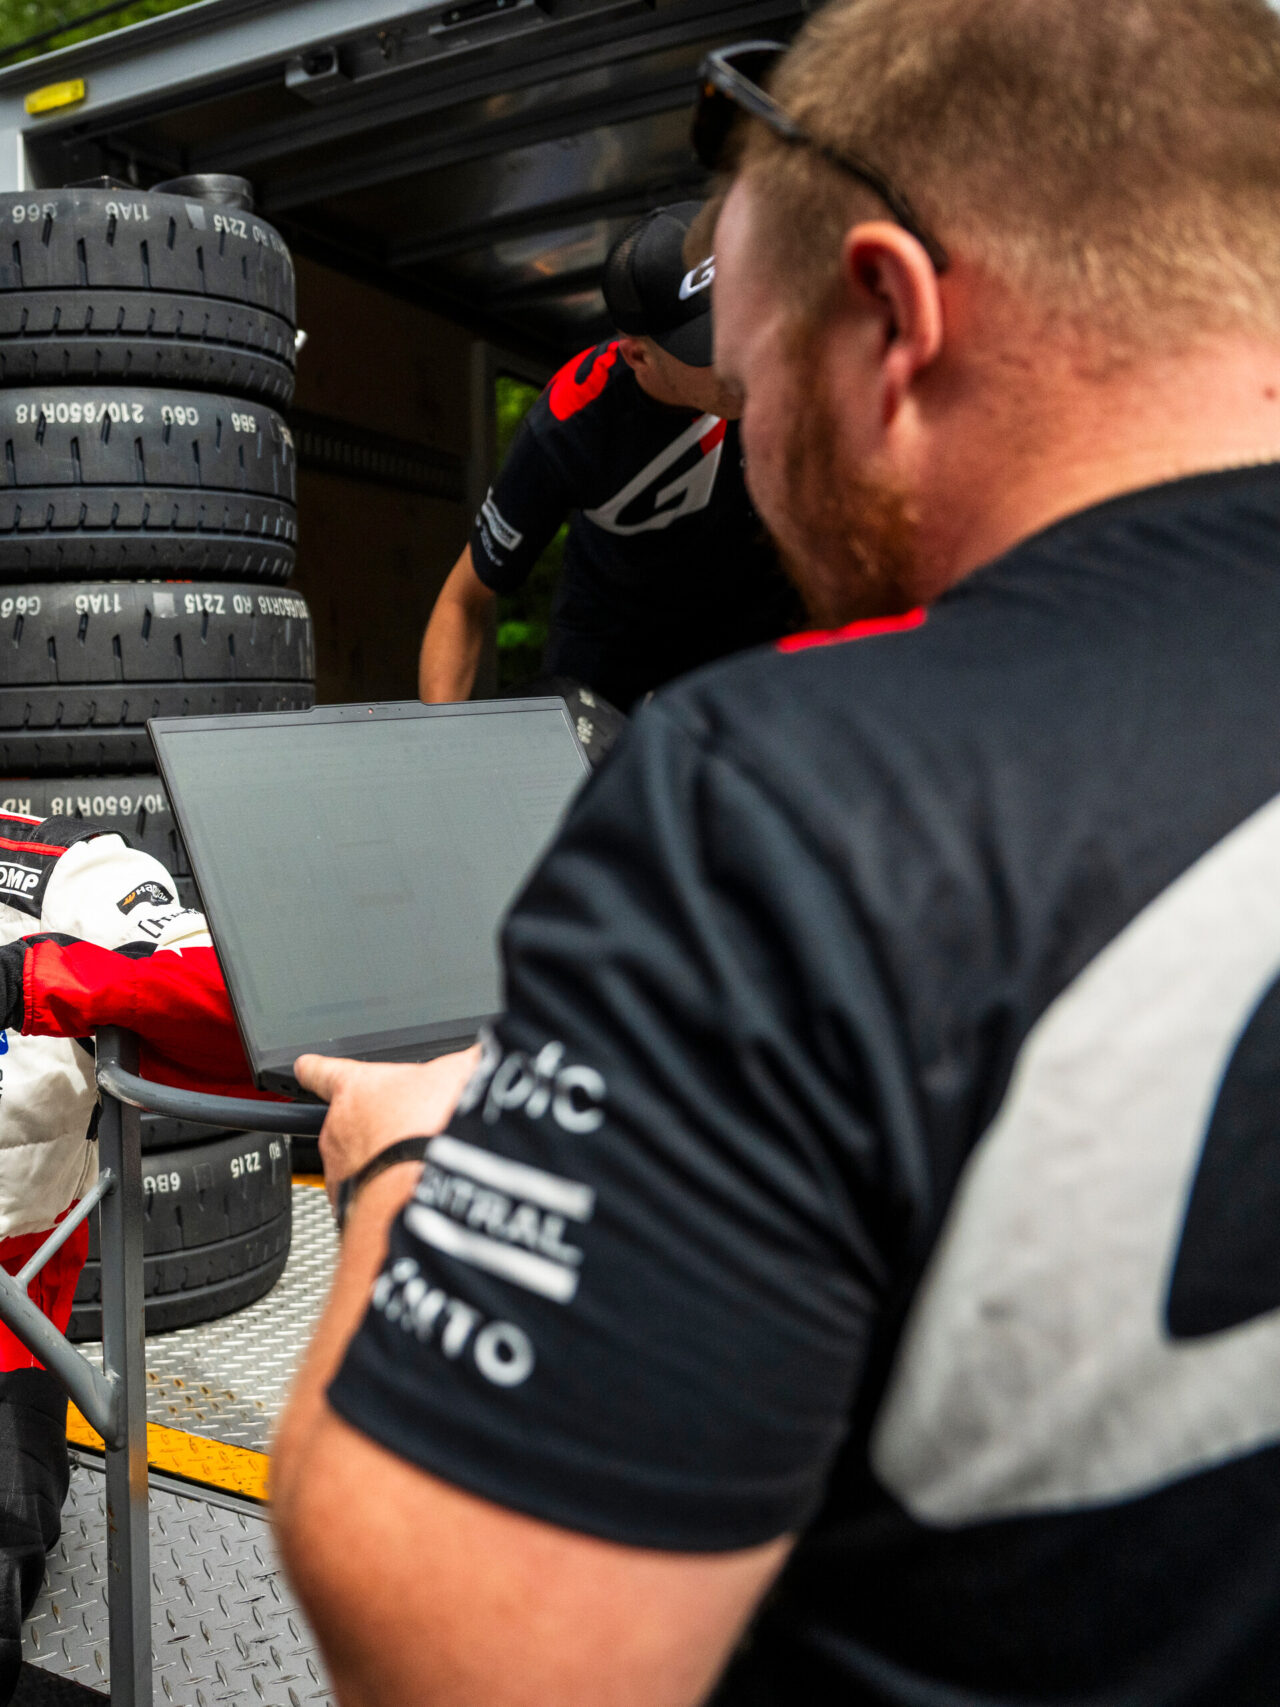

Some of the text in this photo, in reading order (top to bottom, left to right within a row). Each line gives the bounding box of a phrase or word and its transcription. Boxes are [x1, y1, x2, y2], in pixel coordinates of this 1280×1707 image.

[12, 203, 57, 223] G66
[105, 201, 150, 222] 11A6
[213, 215, 247, 238] Z215
[15, 402, 143, 424] 210/650R18
[161, 406, 199, 425] G66
[1, 596, 41, 618] G66
[75, 593, 121, 614] 11A6
[185, 593, 225, 614] Z215
[233, 595, 252, 614] RD
[51, 794, 167, 816] 10/650R18
[230, 1151, 261, 1178] Z215
